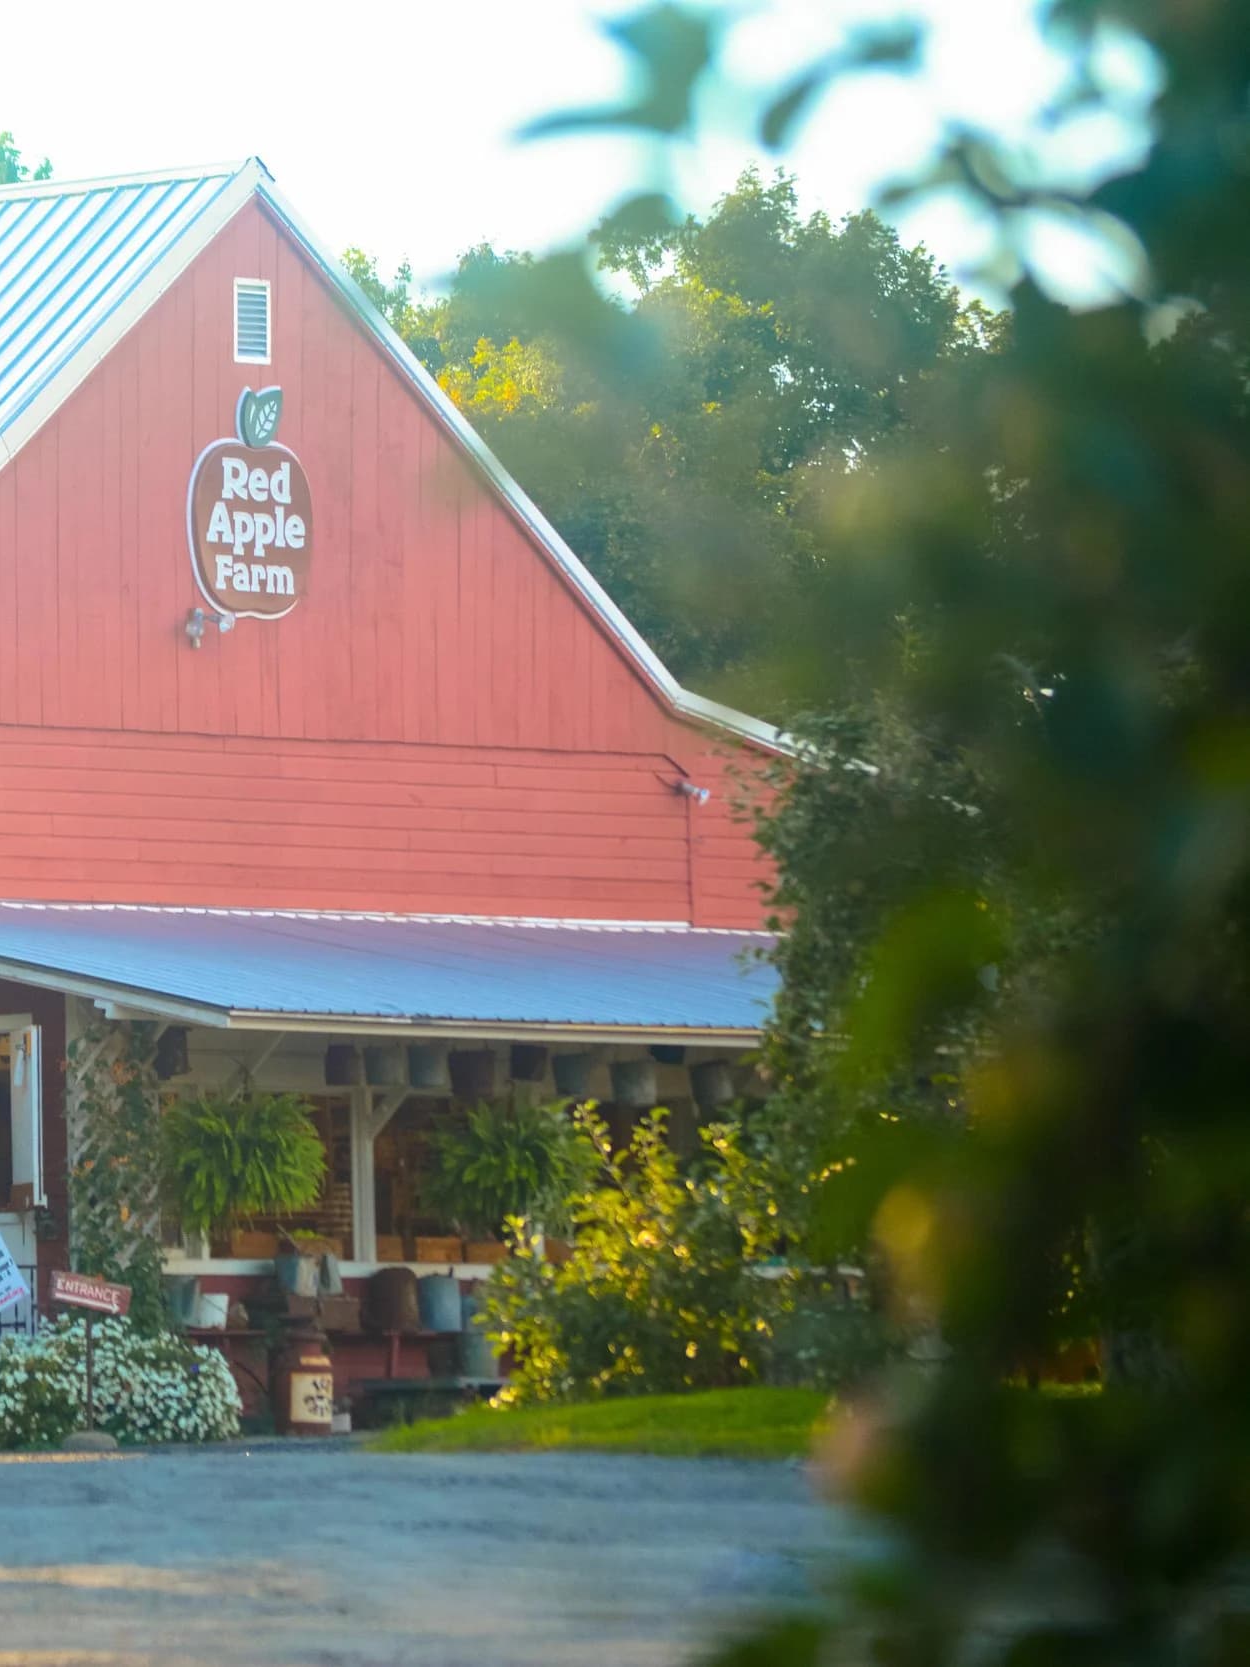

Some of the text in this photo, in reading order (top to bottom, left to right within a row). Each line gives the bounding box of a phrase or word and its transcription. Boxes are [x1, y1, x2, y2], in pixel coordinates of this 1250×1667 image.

[221, 457, 292, 504] Red
[206, 501, 306, 557] Apple
[215, 554, 295, 595] Farm
[56, 1278, 120, 1304] ENTRANCE
